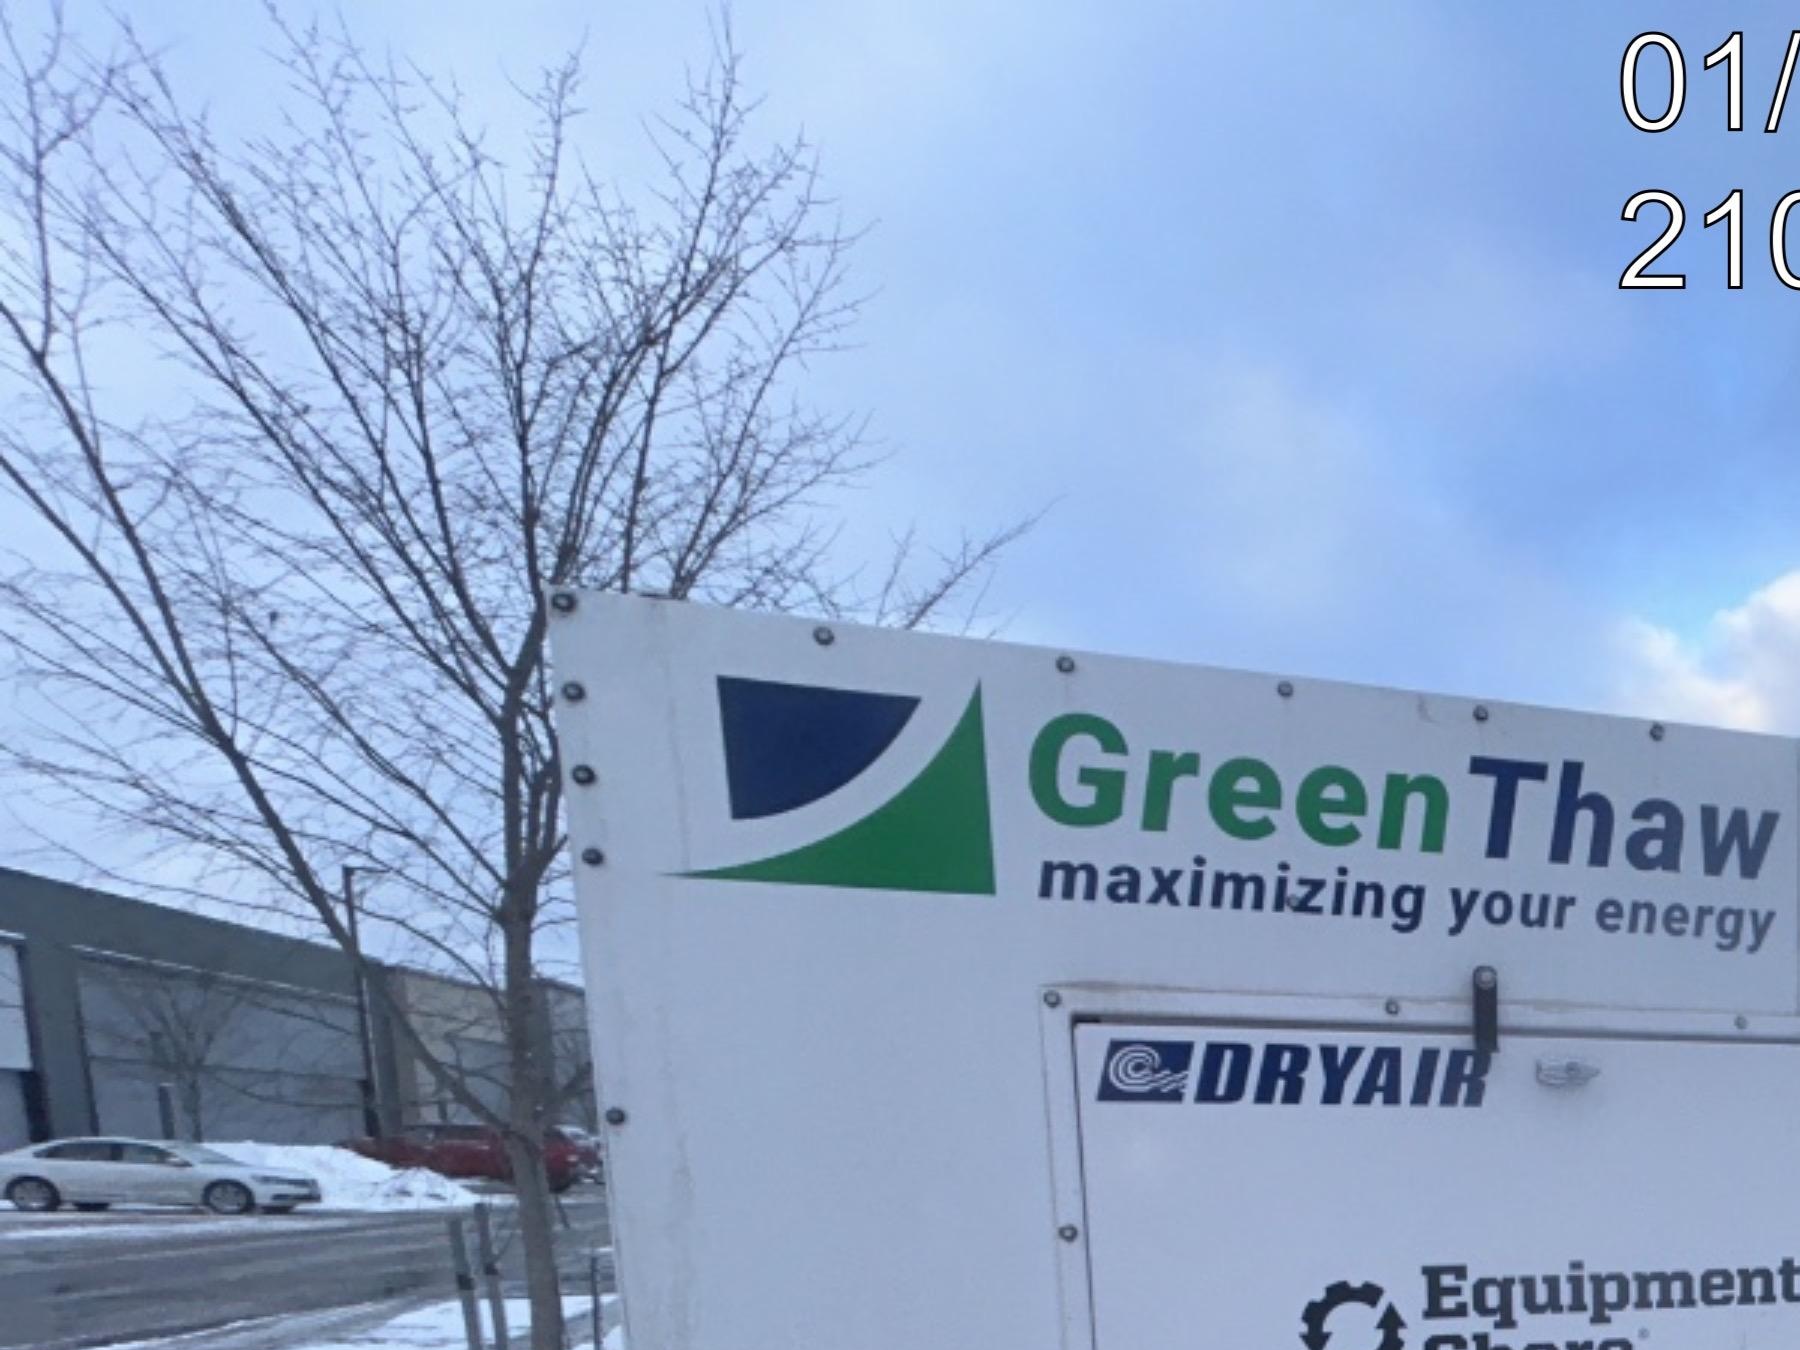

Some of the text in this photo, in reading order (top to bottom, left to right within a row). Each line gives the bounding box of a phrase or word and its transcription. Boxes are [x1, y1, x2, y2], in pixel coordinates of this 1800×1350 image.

[1038, 855, 1778, 955] maximizing your energy
[1194, 1042, 1491, 1108] DRYAIR
